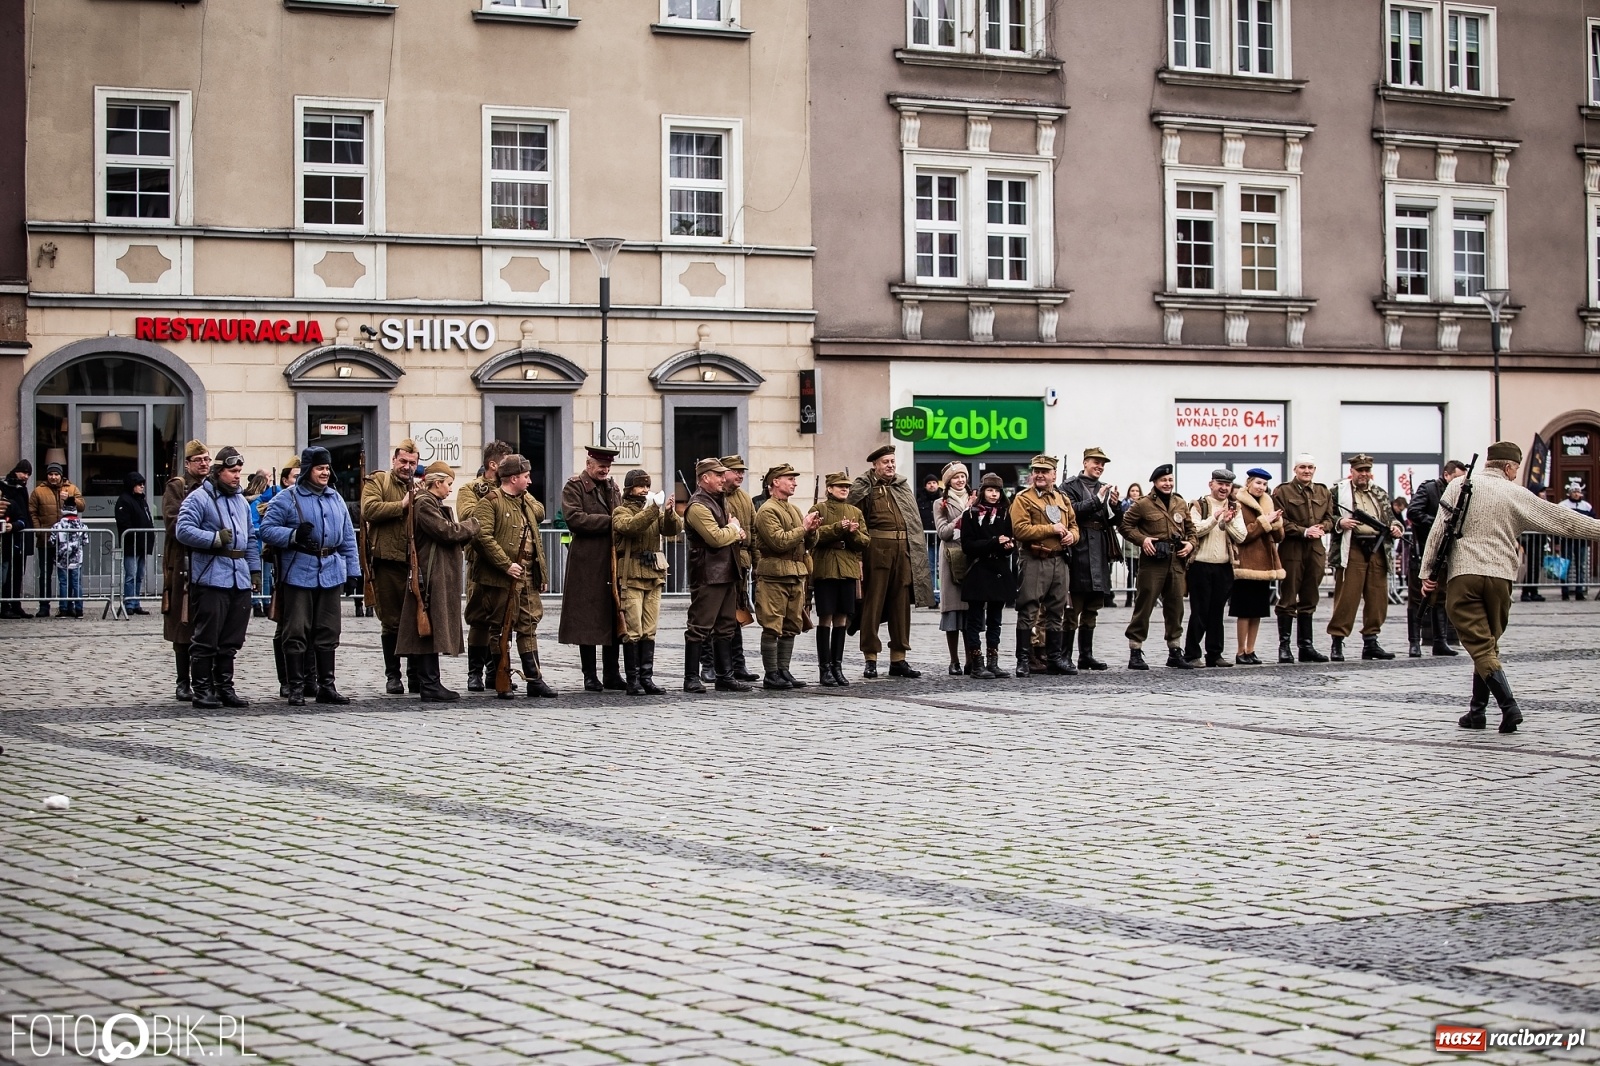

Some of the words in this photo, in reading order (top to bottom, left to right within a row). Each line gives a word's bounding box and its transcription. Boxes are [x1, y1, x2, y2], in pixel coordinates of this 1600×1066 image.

[135, 316, 324, 343] RESTAURACJA
[380, 318, 496, 351] SHIRO
[1176, 407, 1218, 417] LOKAL
[1222, 408, 1239, 417] DO
[895, 415, 924, 430] żabka
[933, 409, 1028, 440] żabka
[1176, 418, 1239, 429] WYNAJĘCIA
[1176, 440, 1188, 448] tel.
[1191, 434, 1217, 447] 880
[1222, 434, 1247, 447] 201
[1254, 434, 1279, 447] 117
